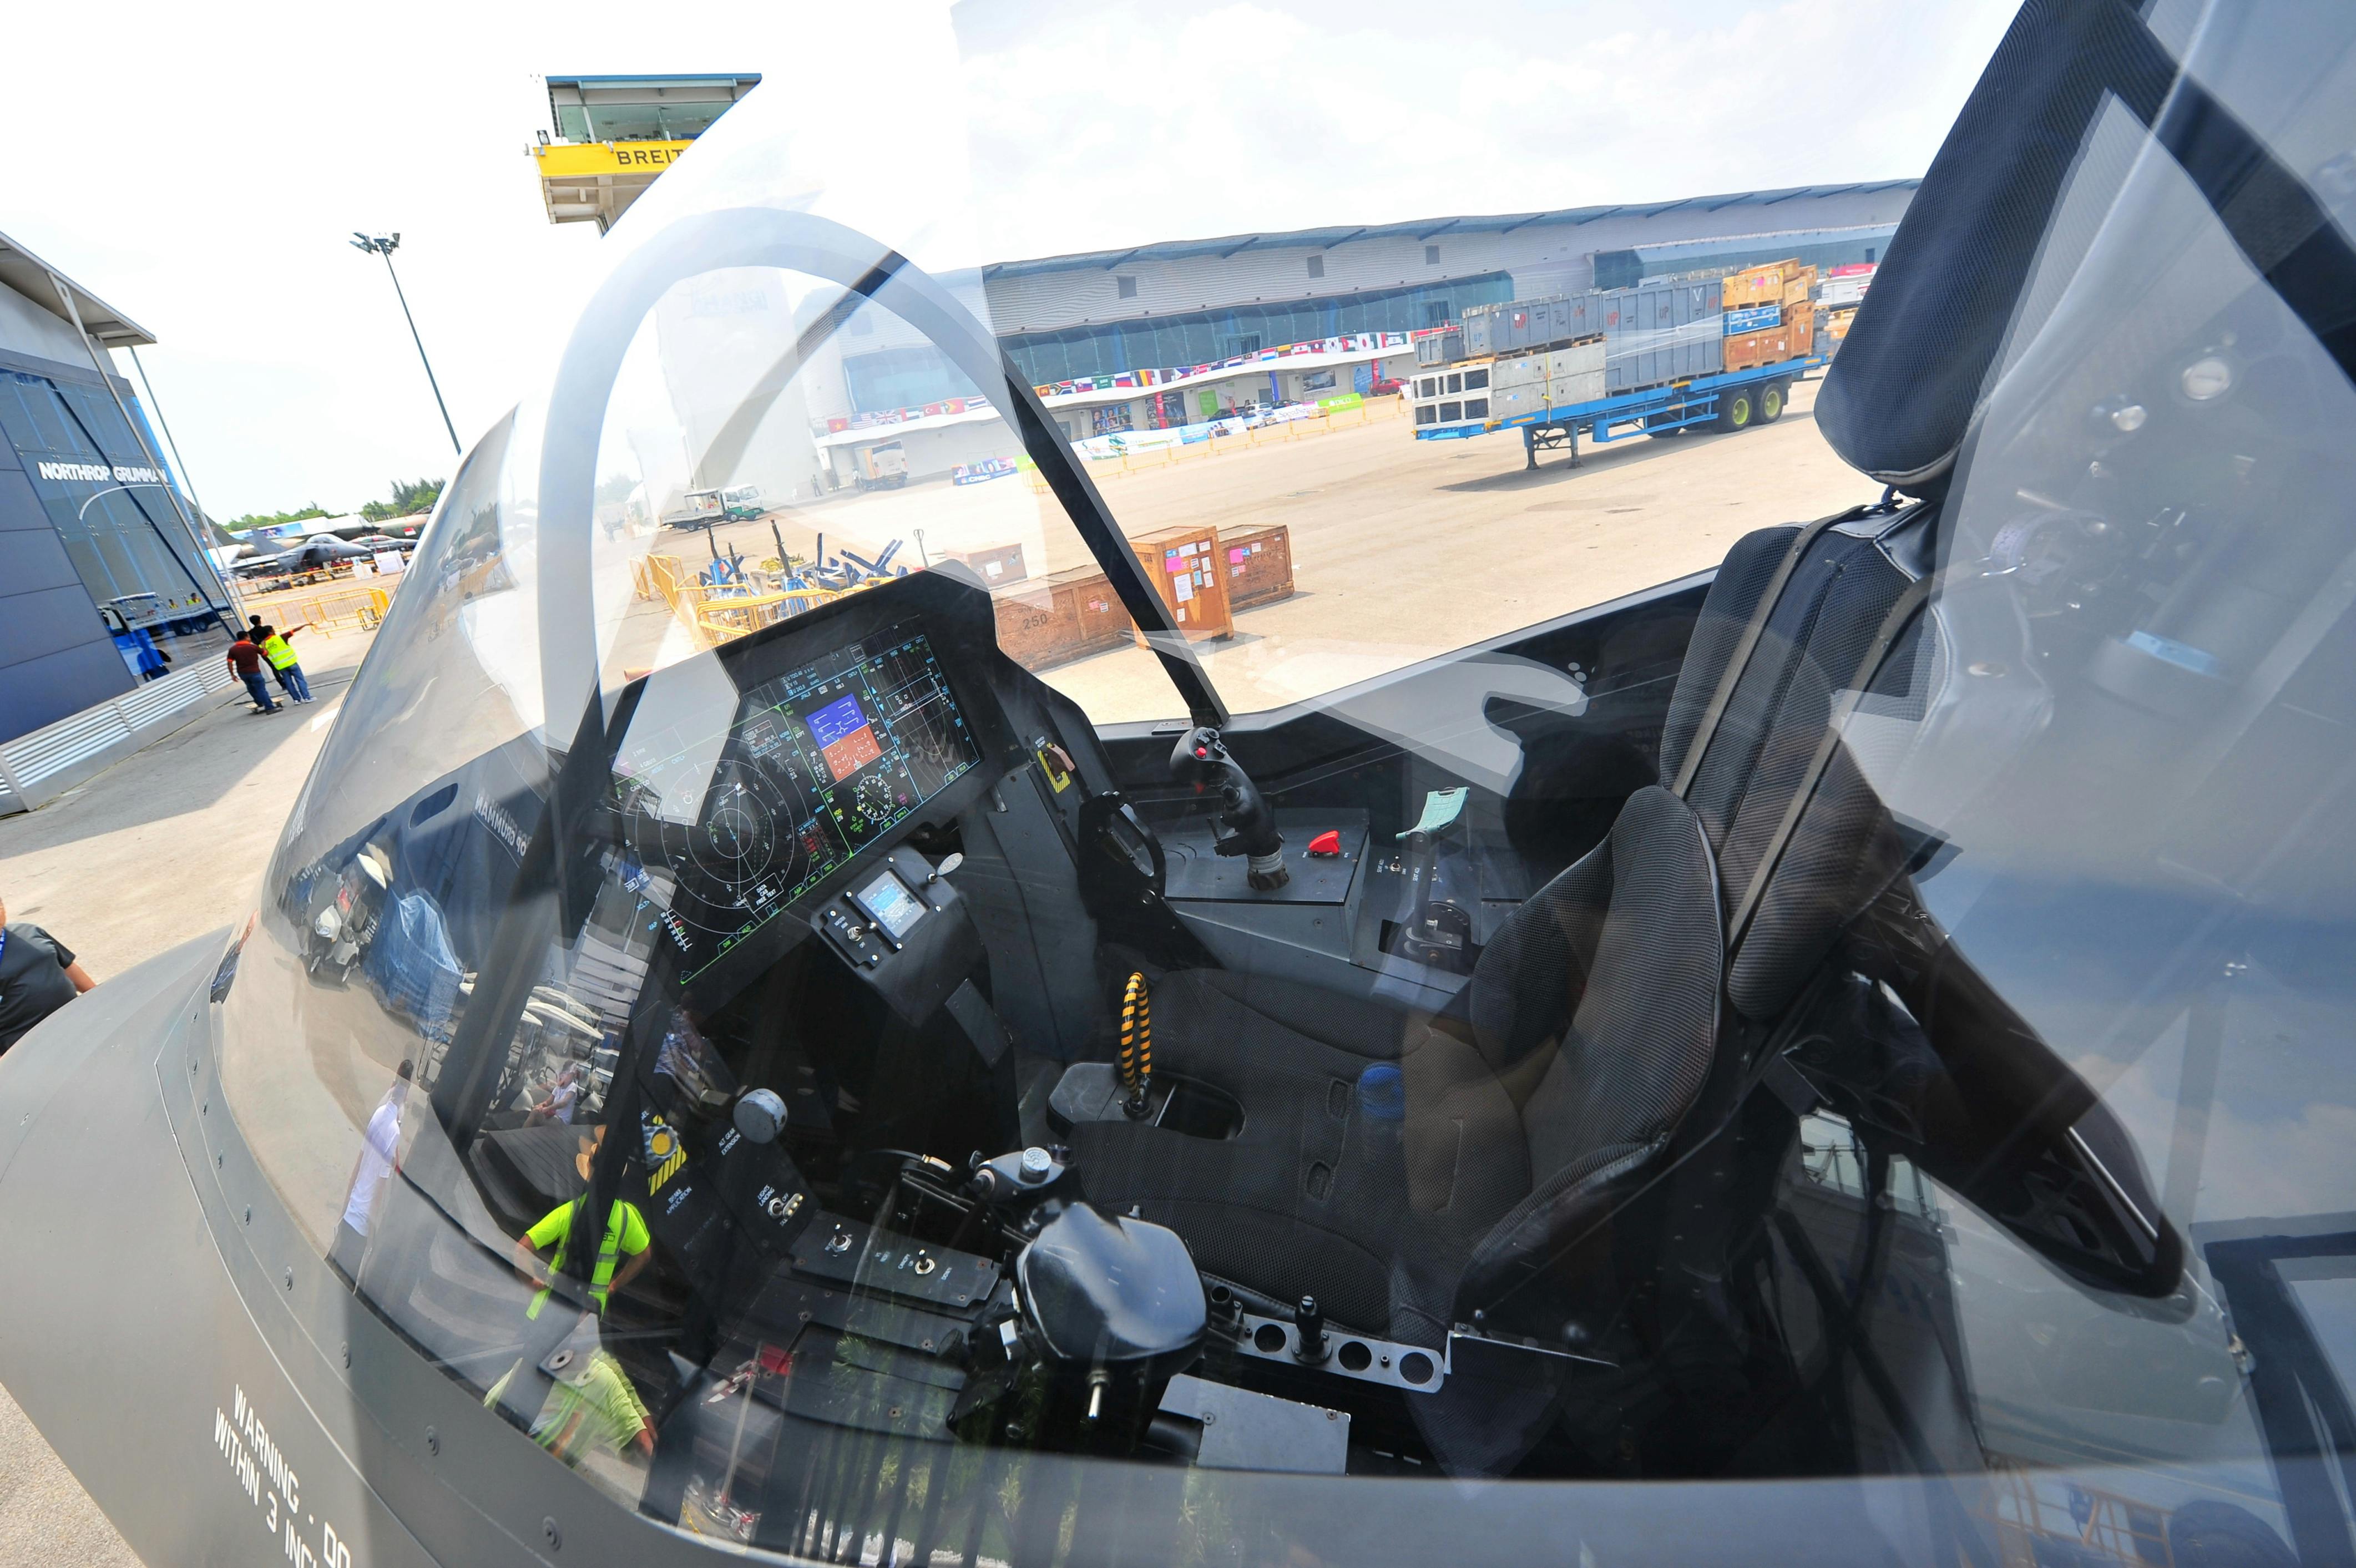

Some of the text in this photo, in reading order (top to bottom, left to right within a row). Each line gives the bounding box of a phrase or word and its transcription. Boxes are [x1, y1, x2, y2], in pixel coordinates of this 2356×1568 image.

[38, 462, 169, 483] NORTHROP GRUMMAN
[1023, 613, 1048, 630] 250
[721, 1132, 741, 1156] EXTENSION
[725, 1128, 736, 1140] GEAR
[757, 1184, 771, 1201] LIGHTS
[759, 1187, 775, 1207] LANDING
[235, 1383, 300, 1514] WARNING
[215, 1407, 317, 1568] WITHIN 3 INC
